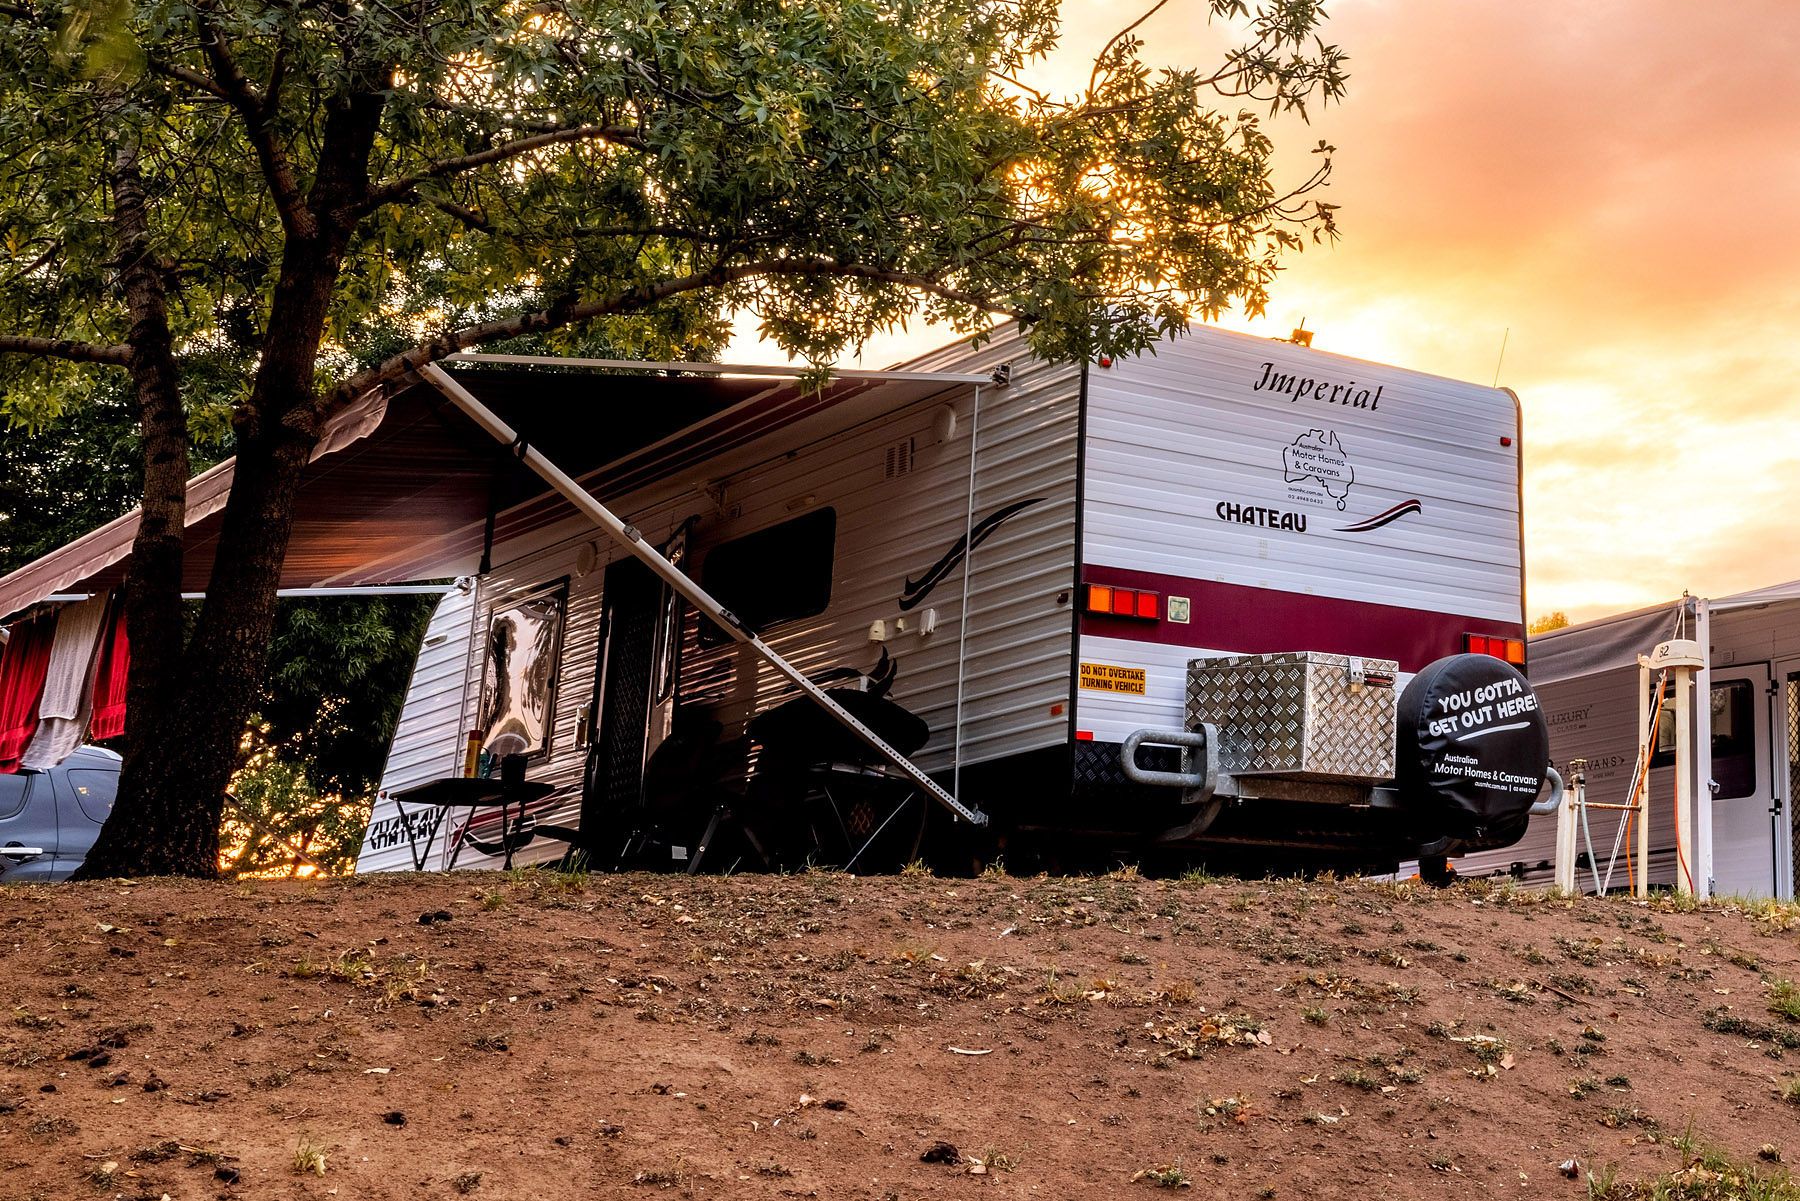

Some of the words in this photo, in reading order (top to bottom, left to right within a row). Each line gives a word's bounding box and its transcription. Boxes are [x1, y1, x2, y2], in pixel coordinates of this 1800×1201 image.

[1253, 362, 1384, 411] Imperial
[1298, 443, 1324, 452] Australian
[1292, 449, 1316, 461] Motor
[1318, 453, 1345, 467] Homes
[1295, 460, 1301, 470] &
[1303, 462, 1340, 477] Caravans
[1216, 501, 1307, 533] CHATEAU
[1081, 665, 1091, 674] DO
[1092, 667, 1107, 677] NOT
[1108, 669, 1145, 681] OVERTAKE
[1082, 677, 1112, 690] TURNING
[1114, 681, 1144, 693] VEHICLE
[1438, 691, 1471, 713] YOU
[1474, 678, 1522, 704] GOTTA
[1429, 715, 1458, 737] GET
[1461, 706, 1492, 728] OUT
[1496, 693, 1538, 719] HERE!
[1546, 708, 1590, 726] LUXURY
[1444, 753, 1478, 765] Australian
[1434, 763, 1463, 776] Motor
[1464, 766, 1491, 780] Homes
[1492, 770, 1498, 781] &
[1499, 771, 1538, 786] Caravans
